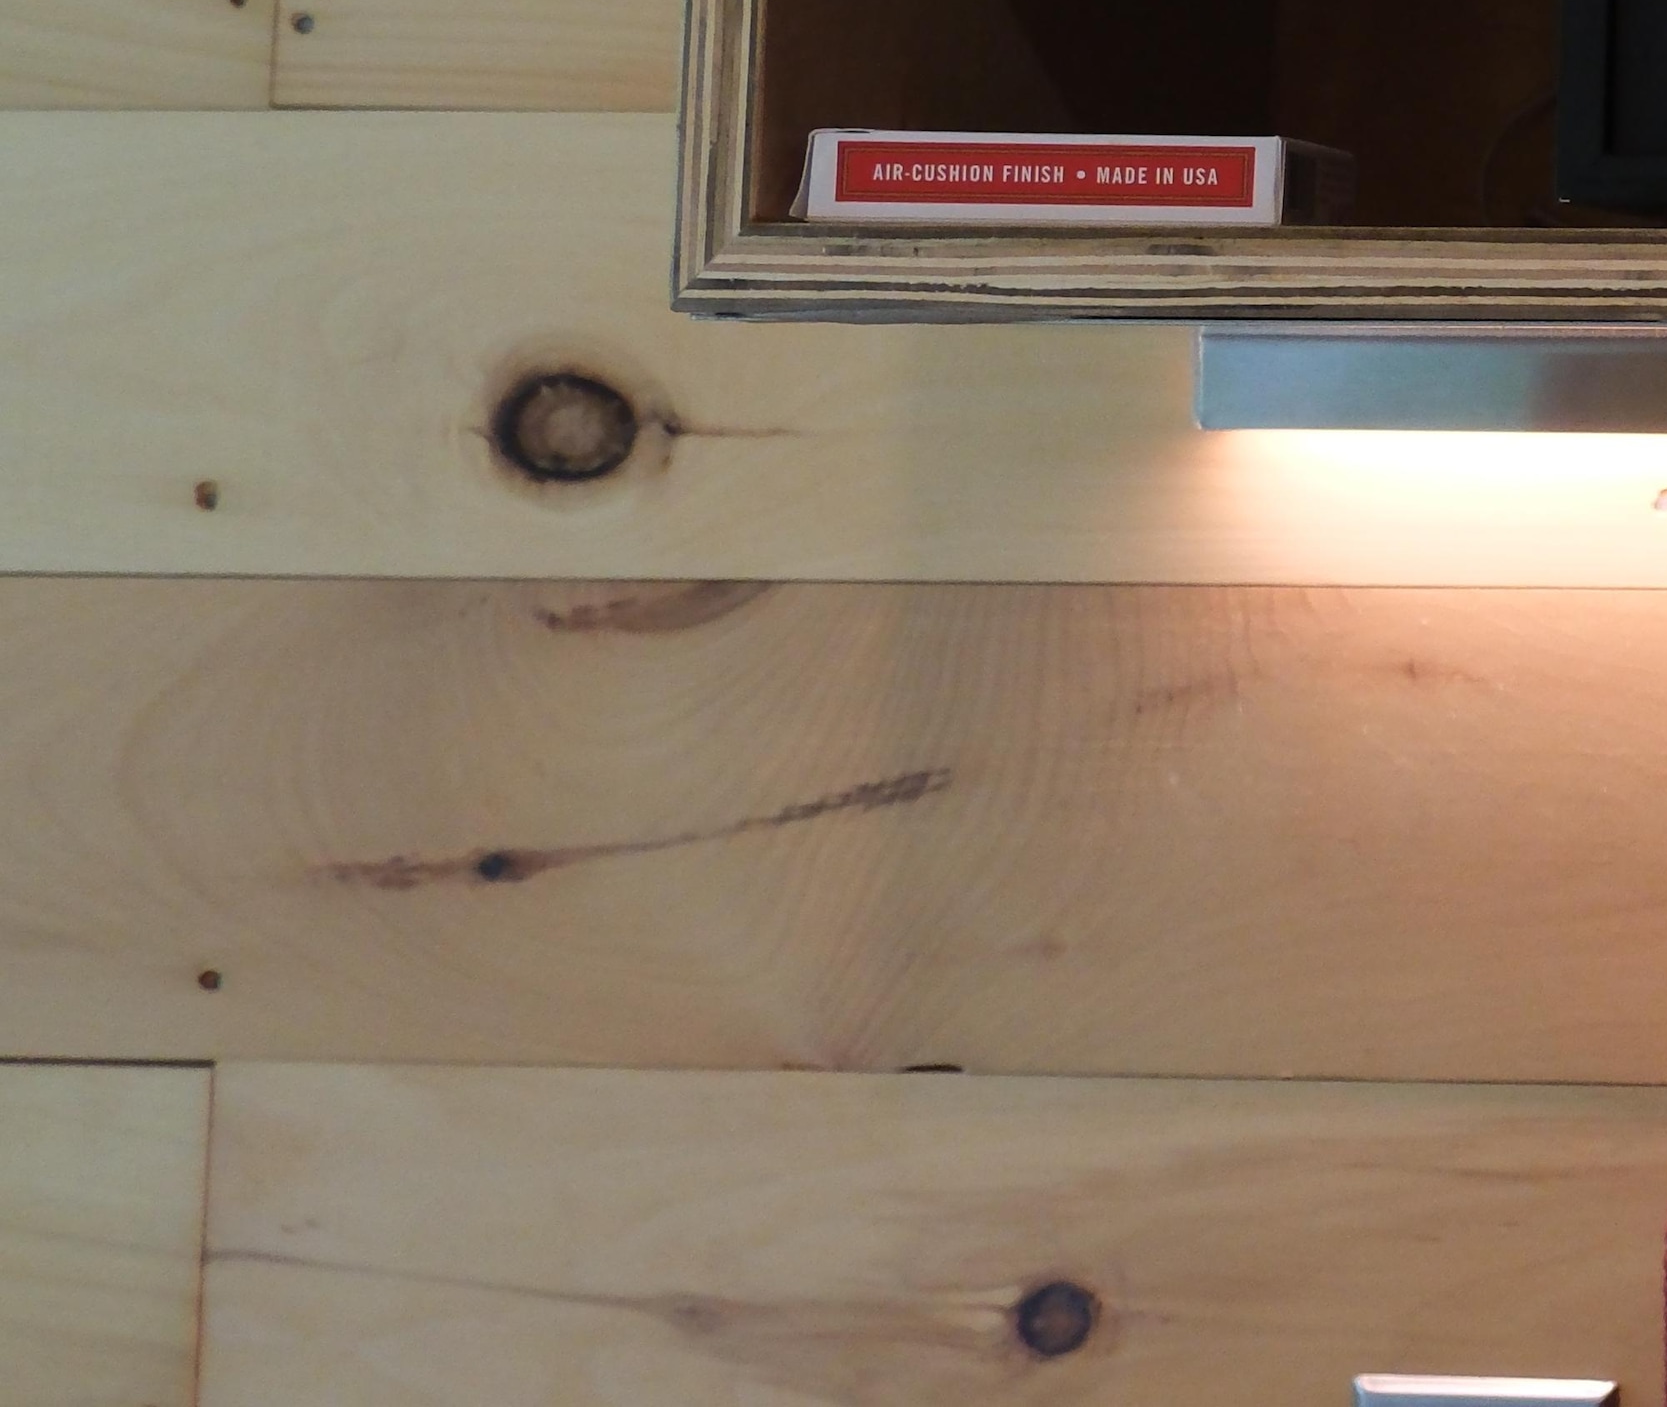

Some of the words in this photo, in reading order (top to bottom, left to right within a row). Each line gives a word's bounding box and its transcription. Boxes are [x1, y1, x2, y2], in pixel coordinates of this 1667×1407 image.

[872, 163, 994, 183] AIR-CUSHION
[1002, 164, 1065, 184] FINISH
[1096, 166, 1148, 185] MADE
[1155, 166, 1175, 185] IN
[1183, 167, 1219, 186] USA
